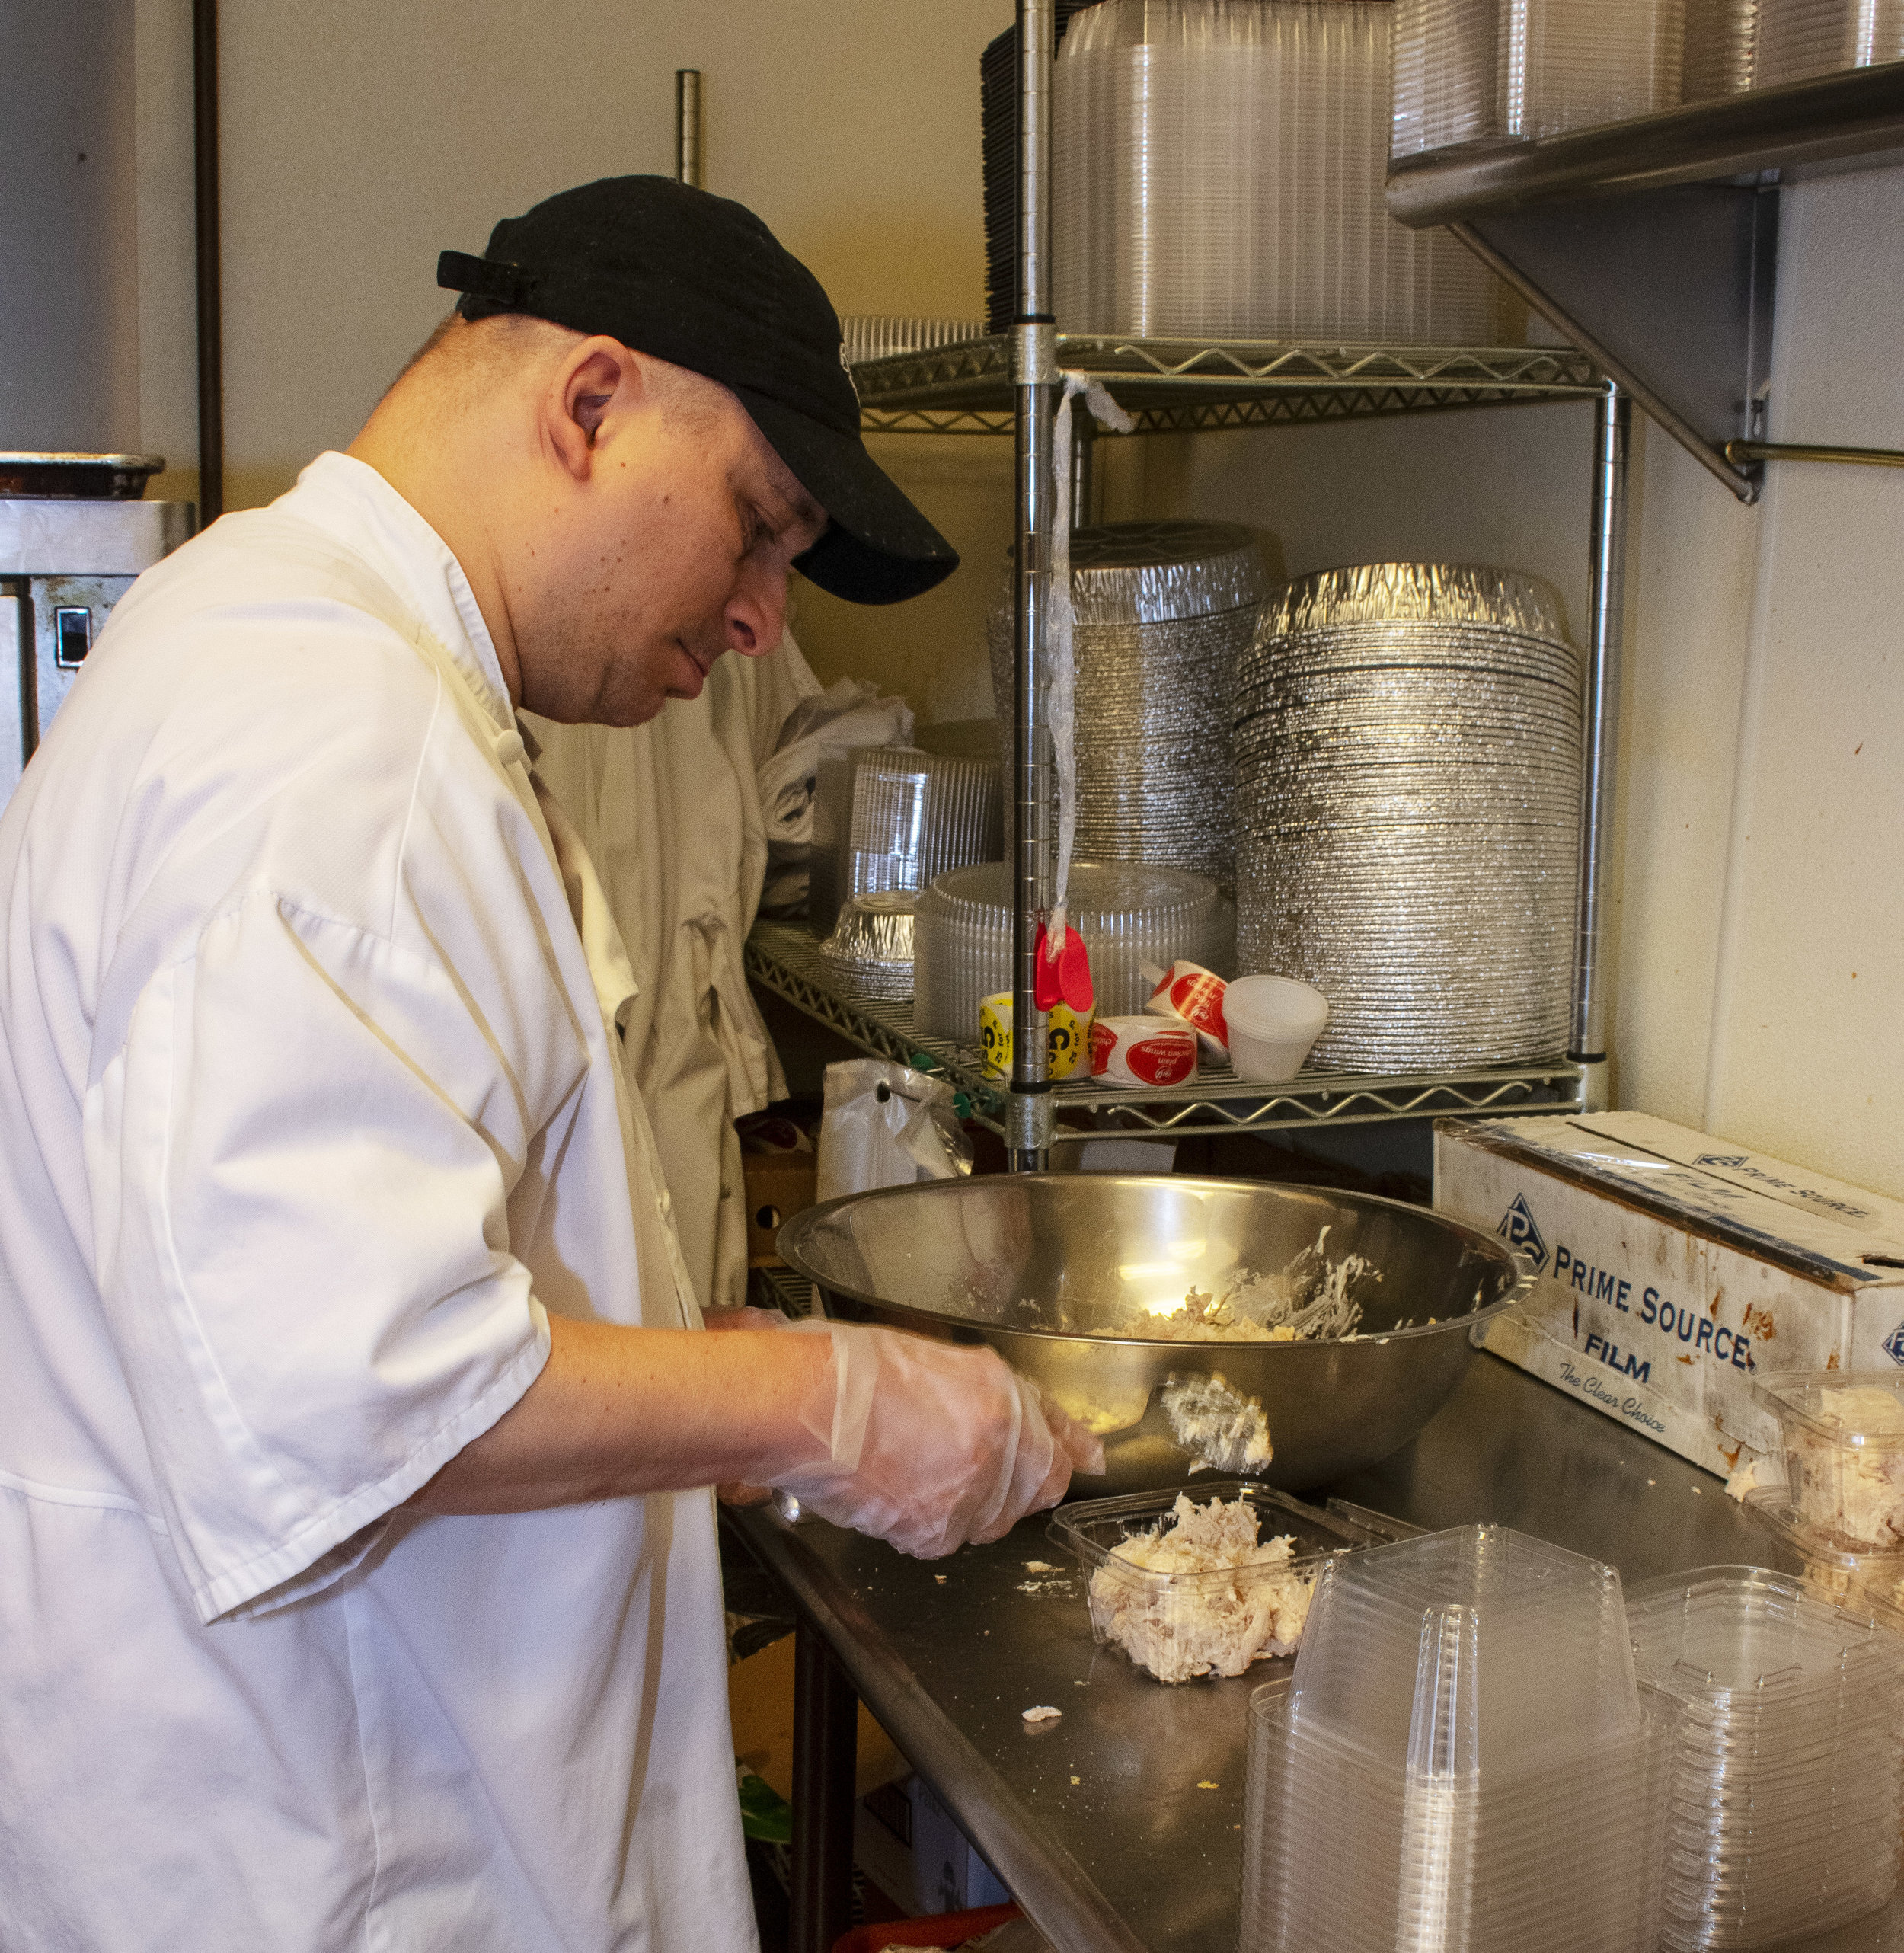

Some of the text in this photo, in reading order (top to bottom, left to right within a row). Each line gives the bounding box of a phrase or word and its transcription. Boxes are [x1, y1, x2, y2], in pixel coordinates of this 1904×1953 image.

[995, 1051, 1003, 1064] 25
[1069, 1051, 1078, 1064] 25
[1141, 1046, 1166, 1056] wings
[1733, 1168, 1869, 1218] PRIME SOURCE
[1554, 1245, 1750, 1370] PRIME SOURCE
[1585, 1333, 1651, 1384] FILM
[1560, 1363, 1666, 1434] The Clear Choice
